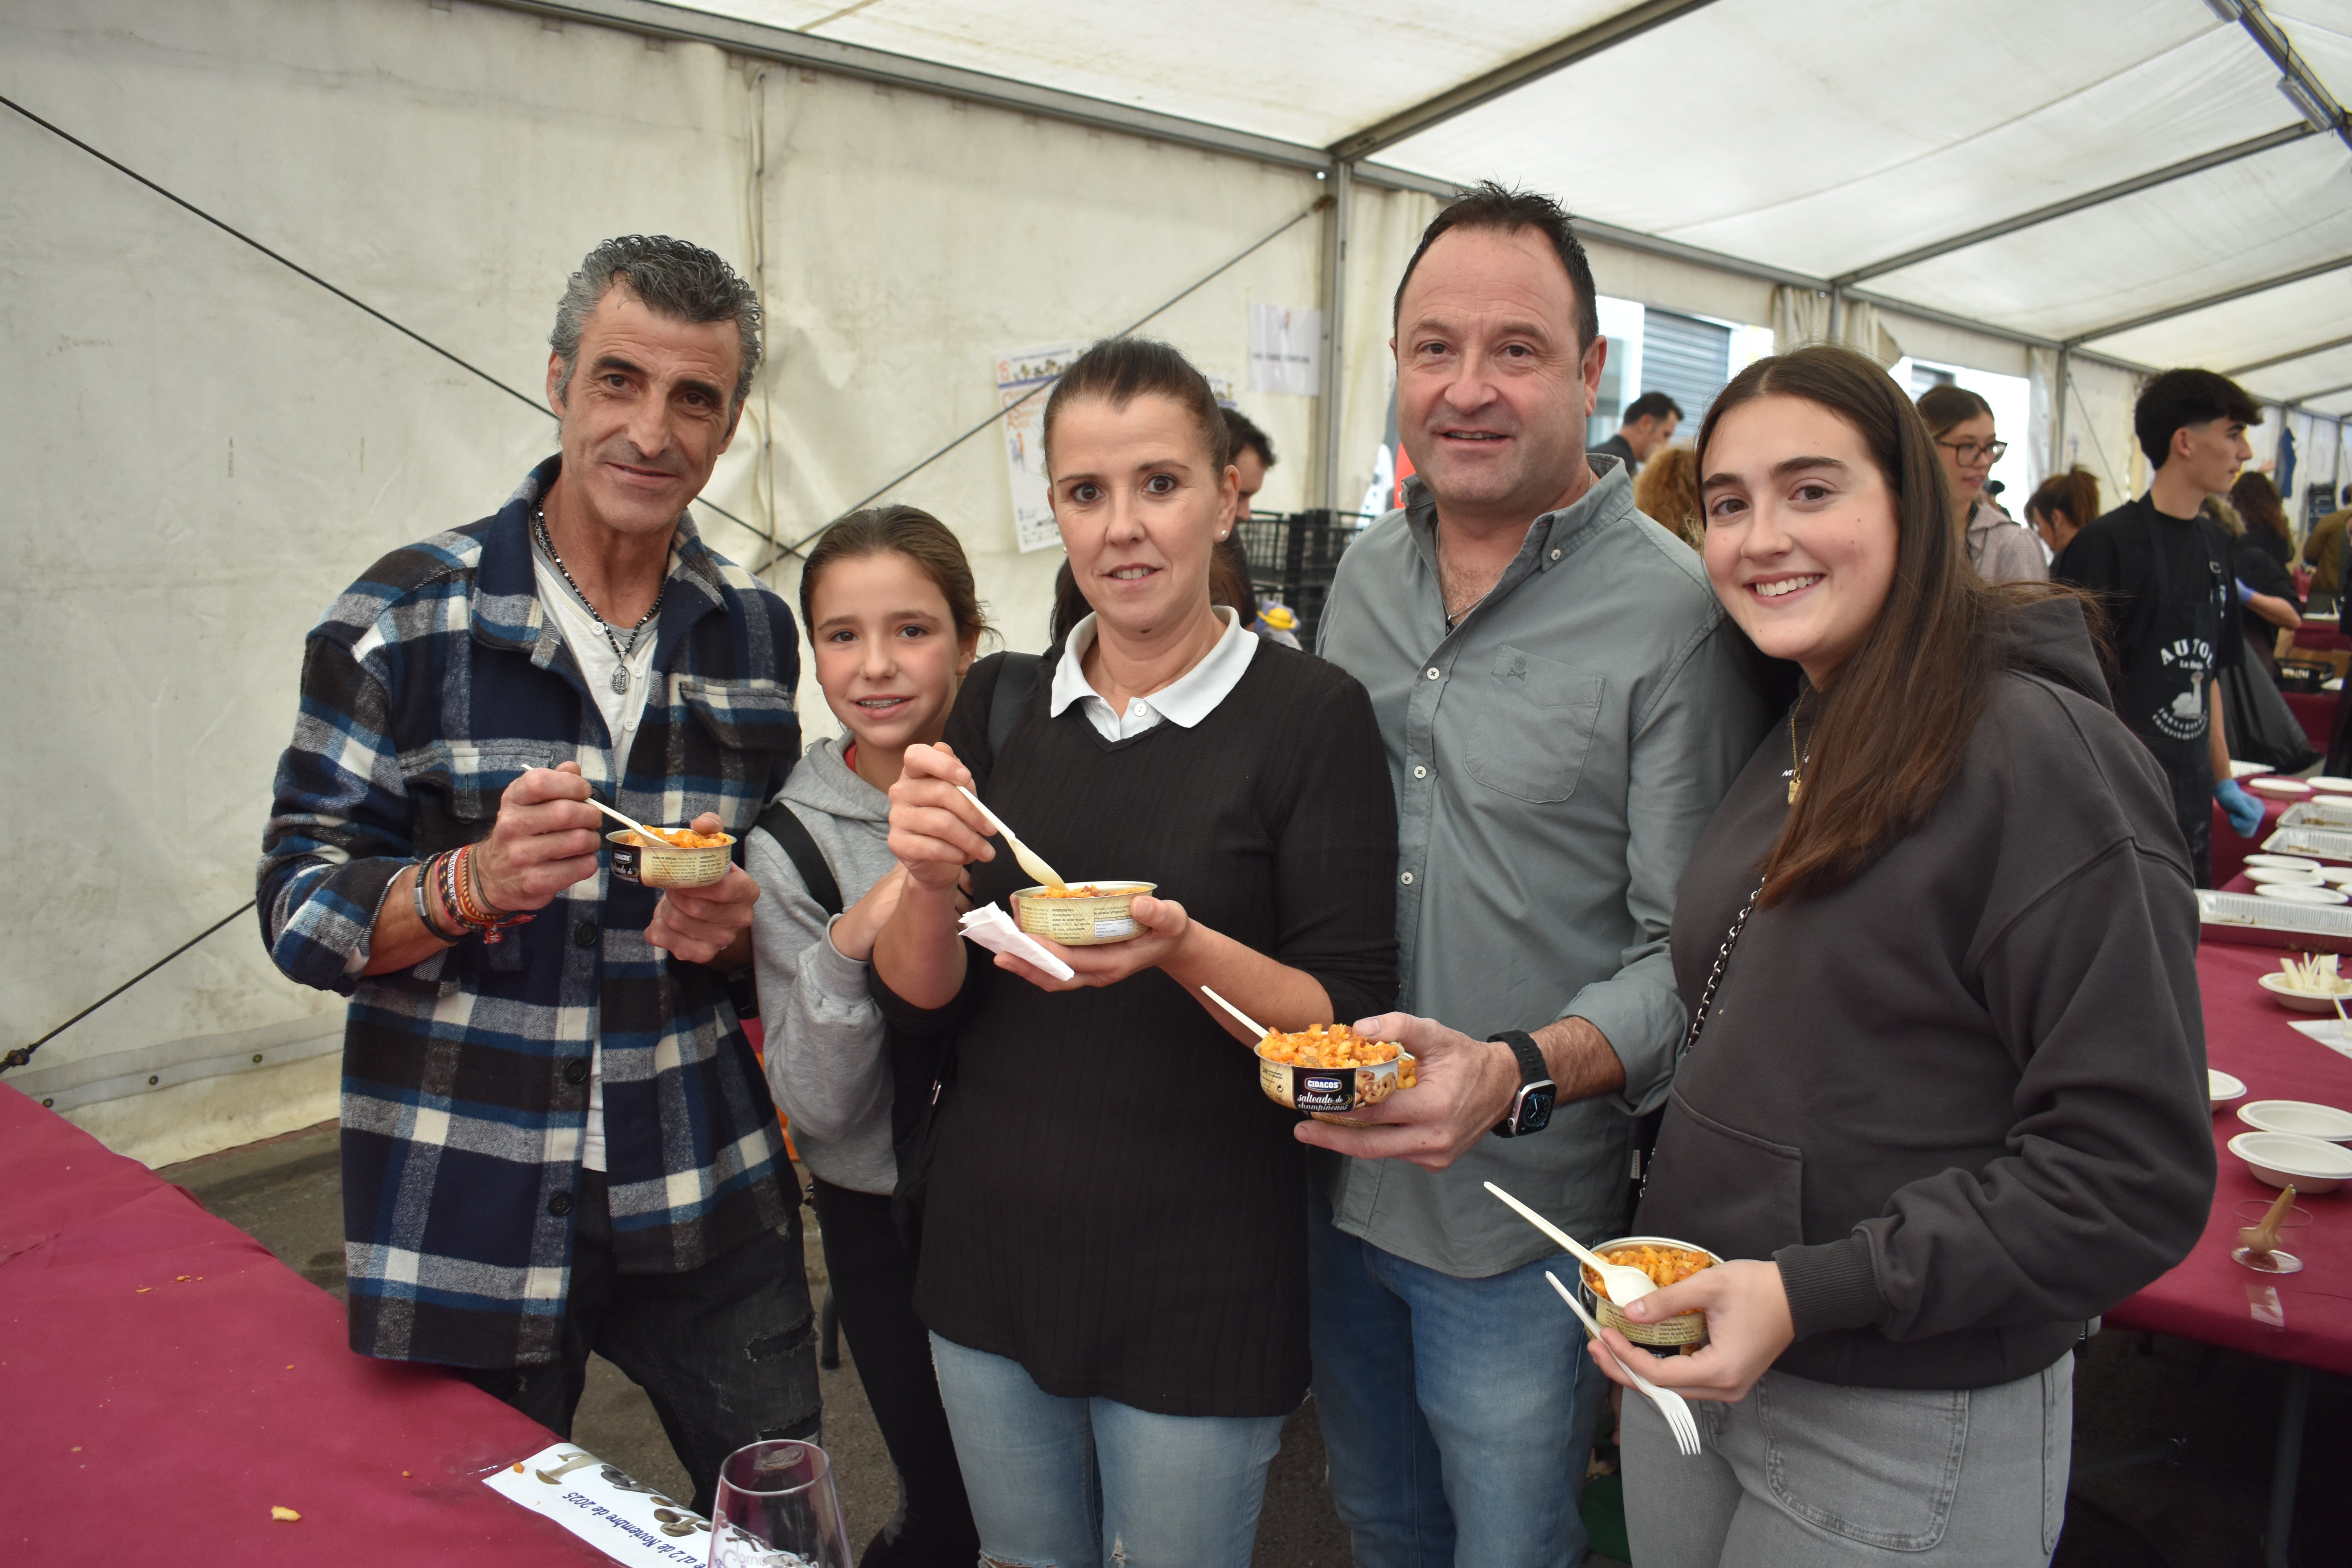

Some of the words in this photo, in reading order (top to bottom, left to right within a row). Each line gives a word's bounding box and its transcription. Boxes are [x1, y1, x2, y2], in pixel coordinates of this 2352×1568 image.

[1307, 1080, 1339, 1089] CIDACOS
[1297, 1092, 1333, 1104] salteado
[1298, 1102, 1348, 1111] champiñones
[562, 1492, 597, 1508] 2025
[592, 1506, 610, 1516] de
[605, 1514, 662, 1548] Noviembre
[657, 1544, 676, 1553] de
[668, 1550, 686, 1559] 2
